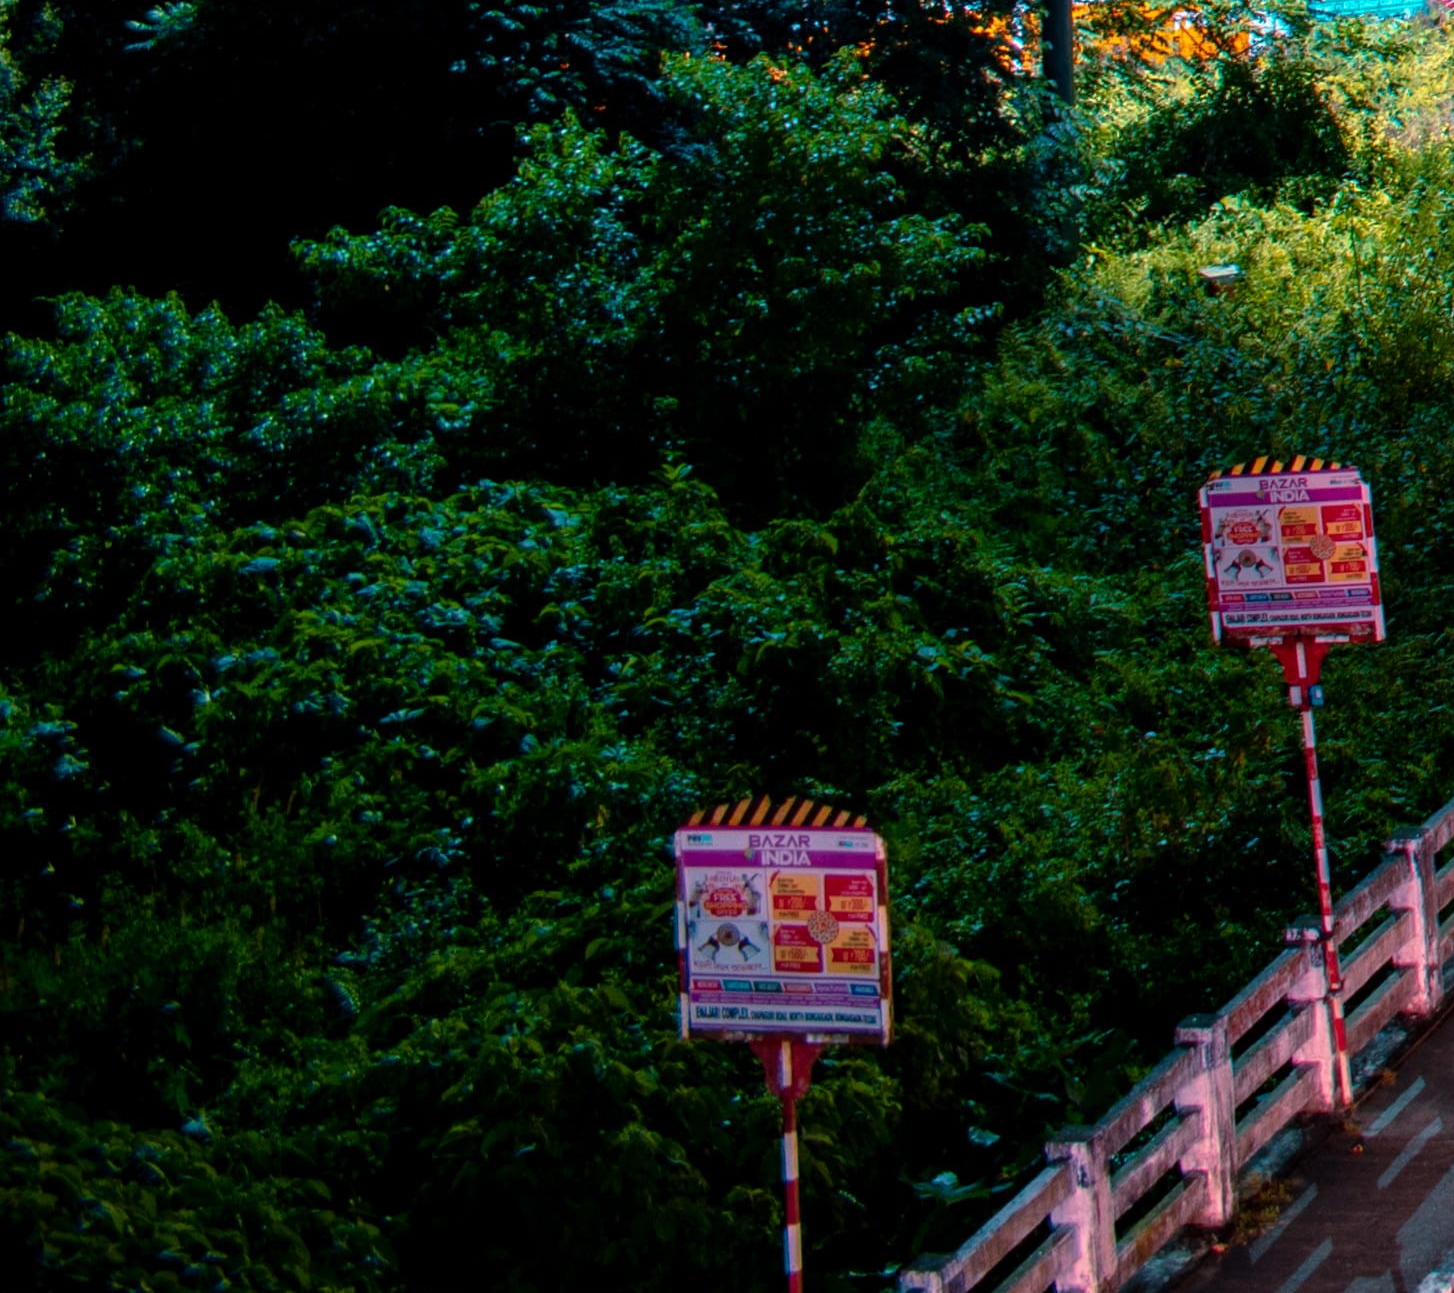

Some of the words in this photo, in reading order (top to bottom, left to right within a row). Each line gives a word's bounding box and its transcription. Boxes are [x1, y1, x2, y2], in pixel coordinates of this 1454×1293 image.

[1259, 478, 1308, 490] BAZAR
[1269, 489, 1310, 502] INDIA
[749, 834, 810, 849] BAZAR
[761, 850, 811, 866] INDIA
